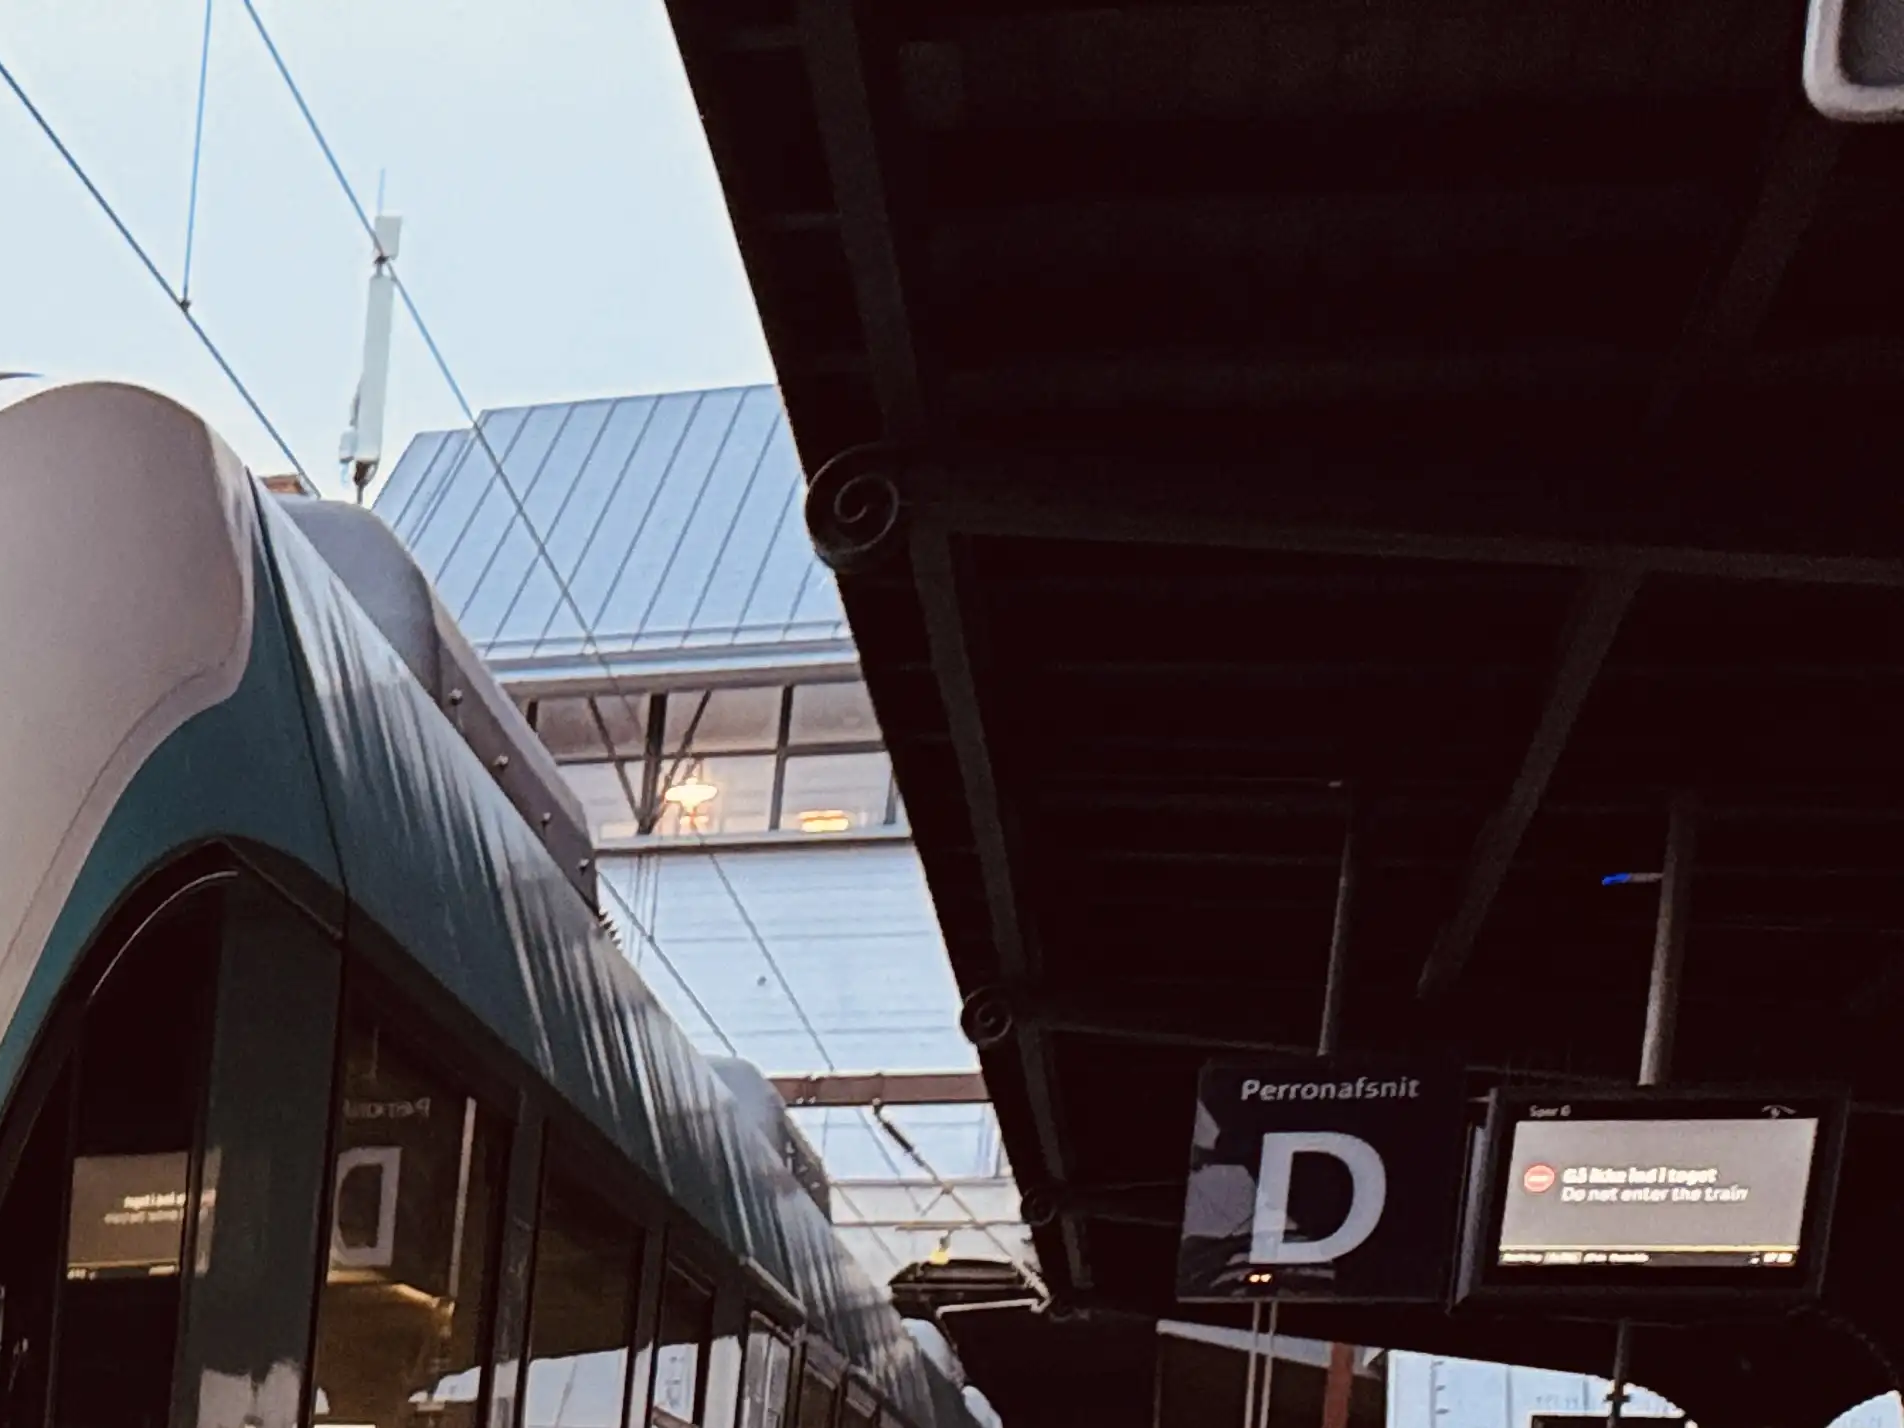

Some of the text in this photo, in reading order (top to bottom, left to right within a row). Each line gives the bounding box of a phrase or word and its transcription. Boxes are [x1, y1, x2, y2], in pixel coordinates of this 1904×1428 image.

[1242, 1076, 1420, 1100] Perronafsnit
[1249, 1131, 1386, 1264] D
[1561, 1184, 1749, 1202] Do not enter the train
